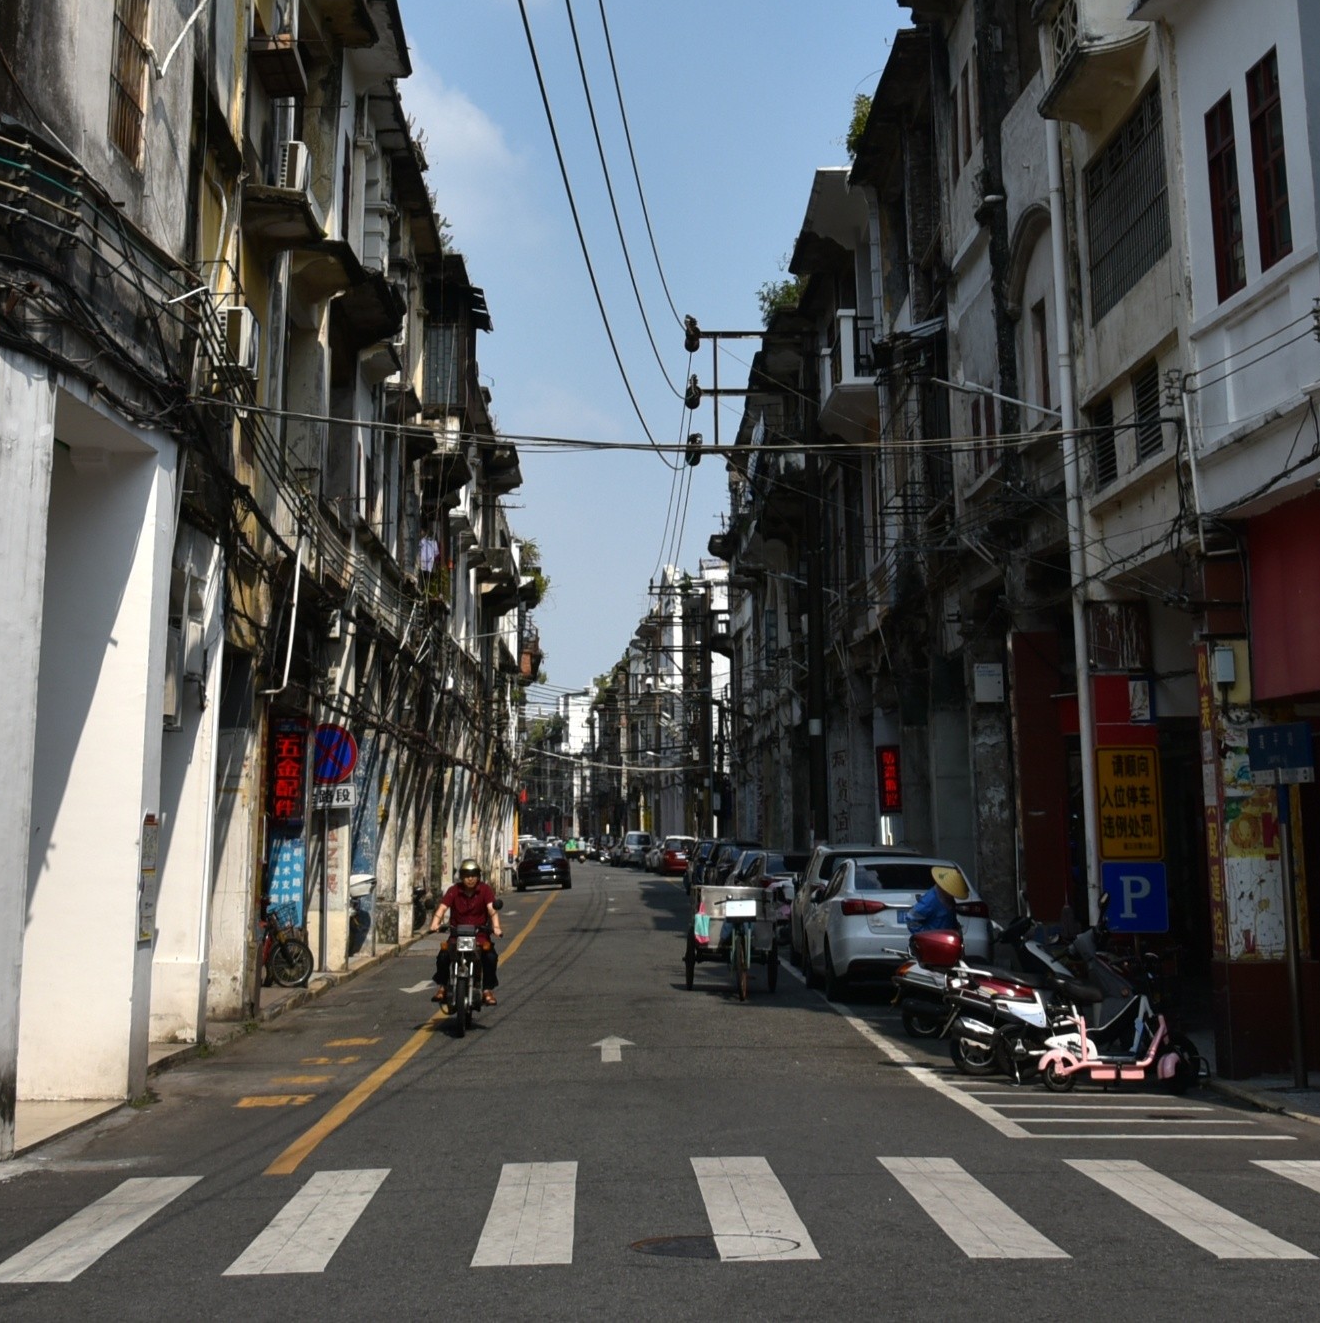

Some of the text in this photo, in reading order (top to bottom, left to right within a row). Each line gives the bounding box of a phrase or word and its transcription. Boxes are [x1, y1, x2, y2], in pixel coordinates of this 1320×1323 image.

[275, 738, 300, 816] 五金配件
[1119, 876, 1151, 918] P
